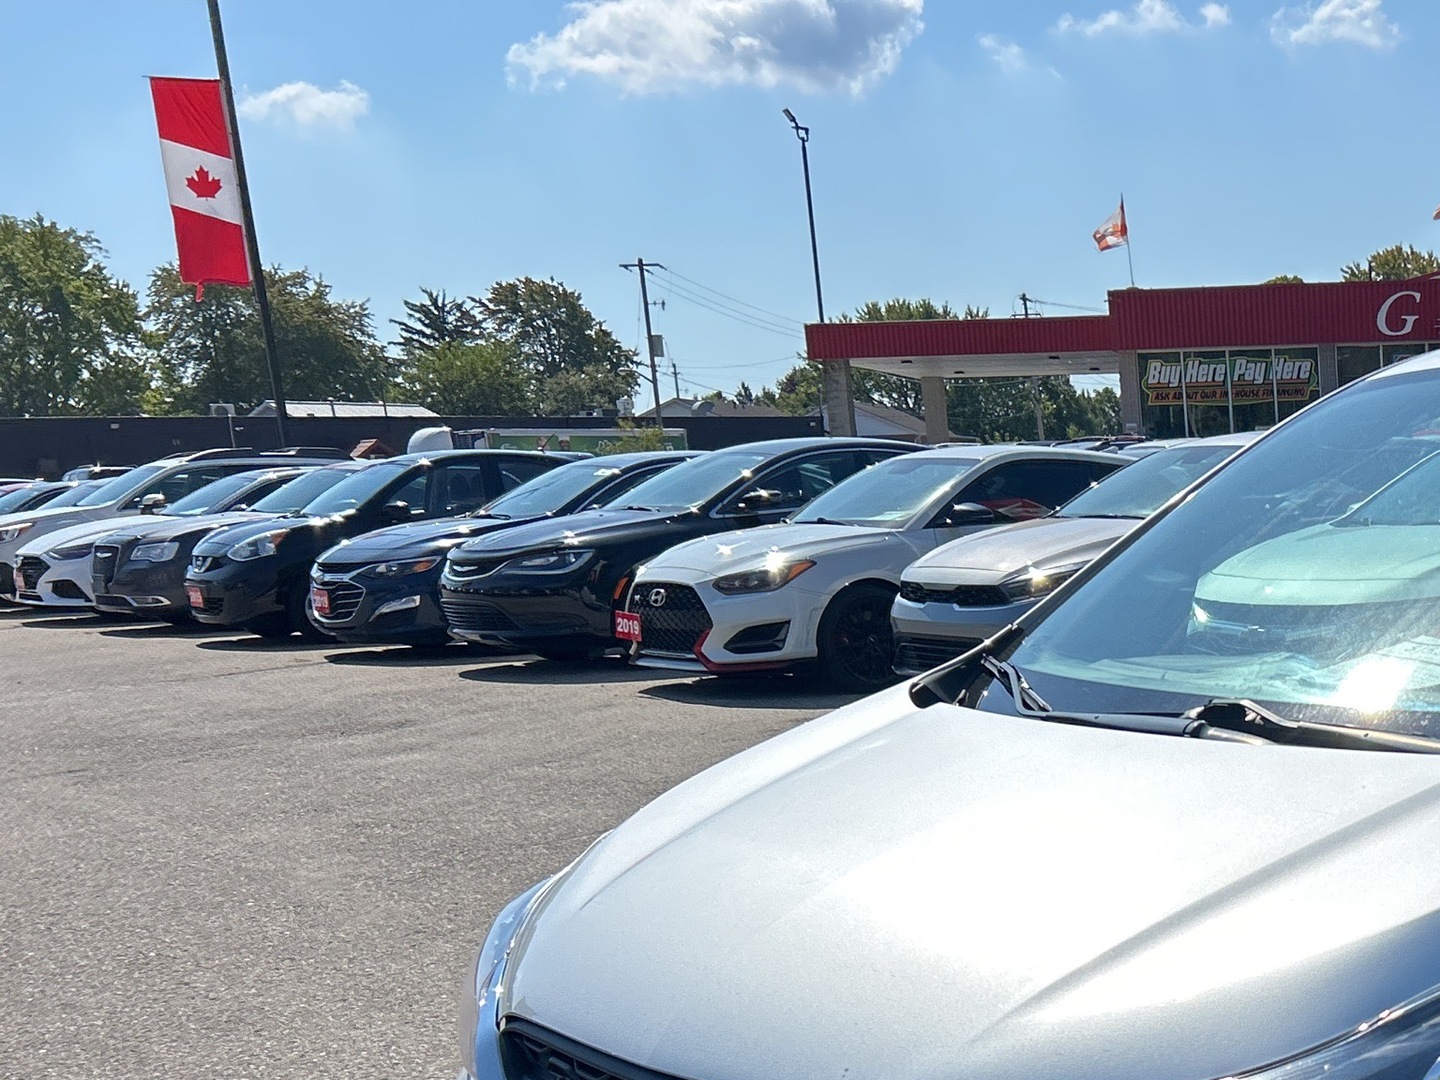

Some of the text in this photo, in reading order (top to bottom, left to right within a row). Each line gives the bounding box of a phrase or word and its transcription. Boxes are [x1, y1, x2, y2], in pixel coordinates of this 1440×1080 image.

[1148, 356, 1313, 388] Buy Here Pay Here
[1154, 391, 1170, 401] ASK
[1200, 389, 1217, 399] OUR
[1261, 386, 1306, 397] FINNCING
[616, 616, 639, 635] 2019
